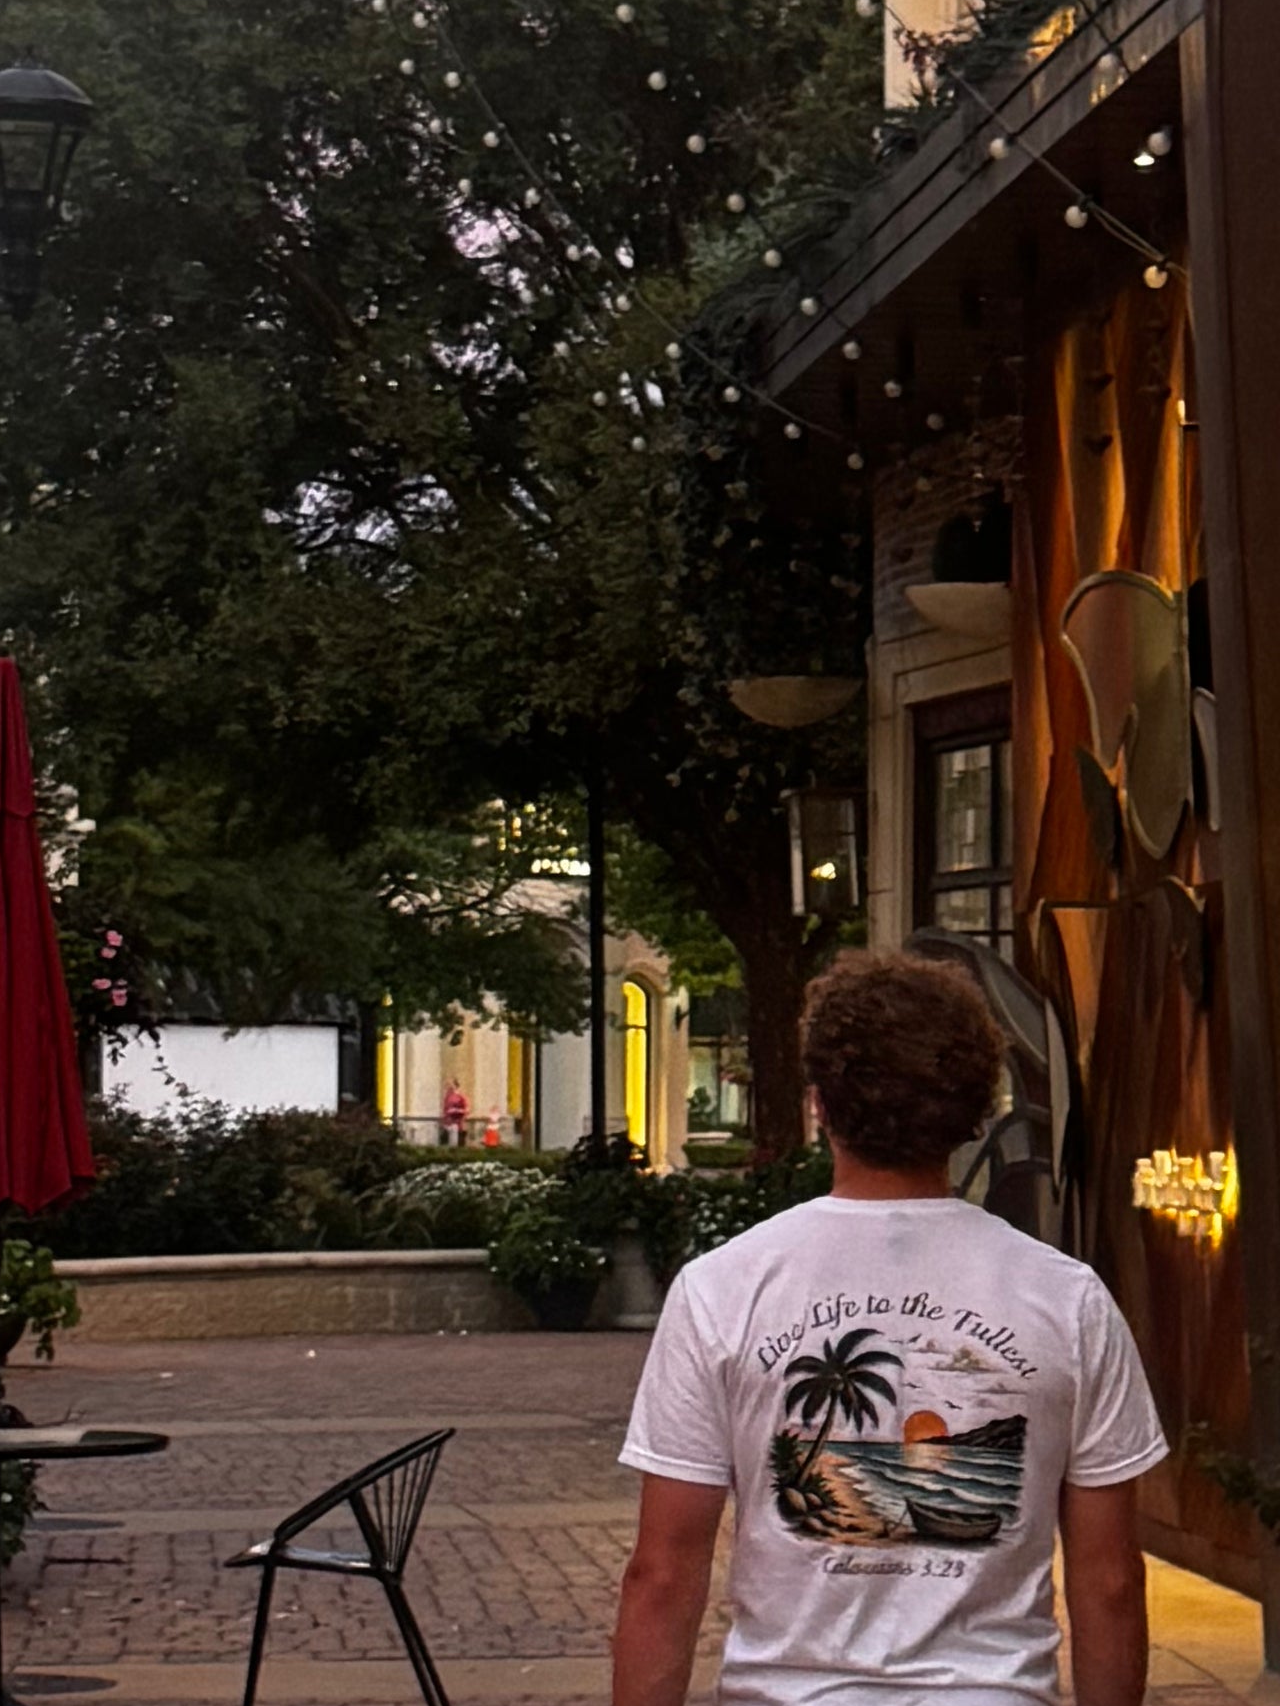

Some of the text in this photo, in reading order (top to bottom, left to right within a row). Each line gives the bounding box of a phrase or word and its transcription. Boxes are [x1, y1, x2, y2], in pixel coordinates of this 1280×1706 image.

[757, 1323, 806, 1372] Live
[811, 1293, 861, 1330] Life
[866, 1294, 893, 1314] to
[900, 1292, 945, 1321] the
